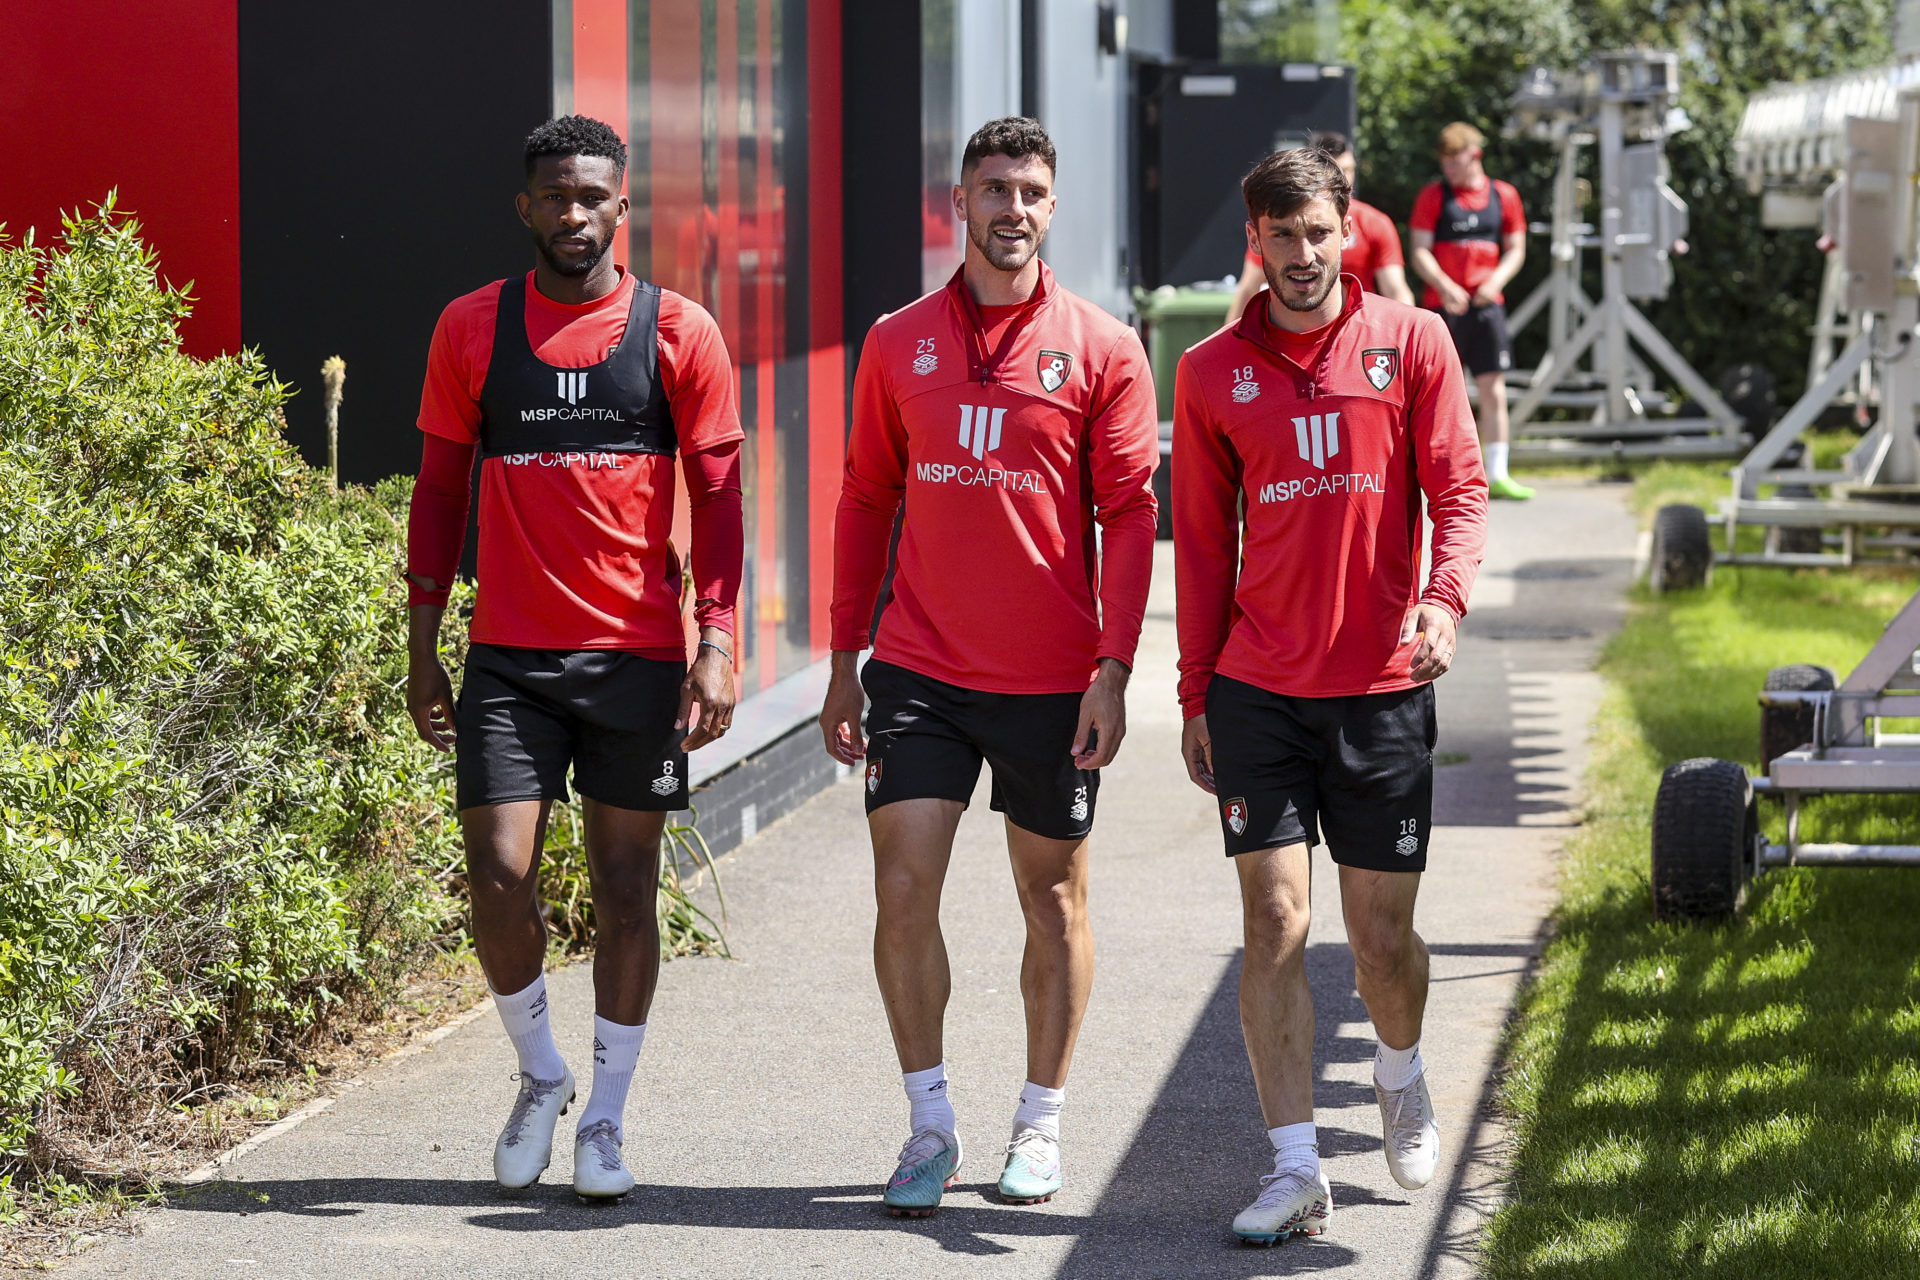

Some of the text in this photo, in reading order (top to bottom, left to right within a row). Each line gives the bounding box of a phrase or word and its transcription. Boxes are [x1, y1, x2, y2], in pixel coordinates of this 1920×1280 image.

[916, 337, 936, 354] 25
[1232, 365, 1254, 383] 18
[663, 760, 674, 775] 8
[1075, 785, 1087, 803] 25
[1400, 818, 1417, 835] 18
